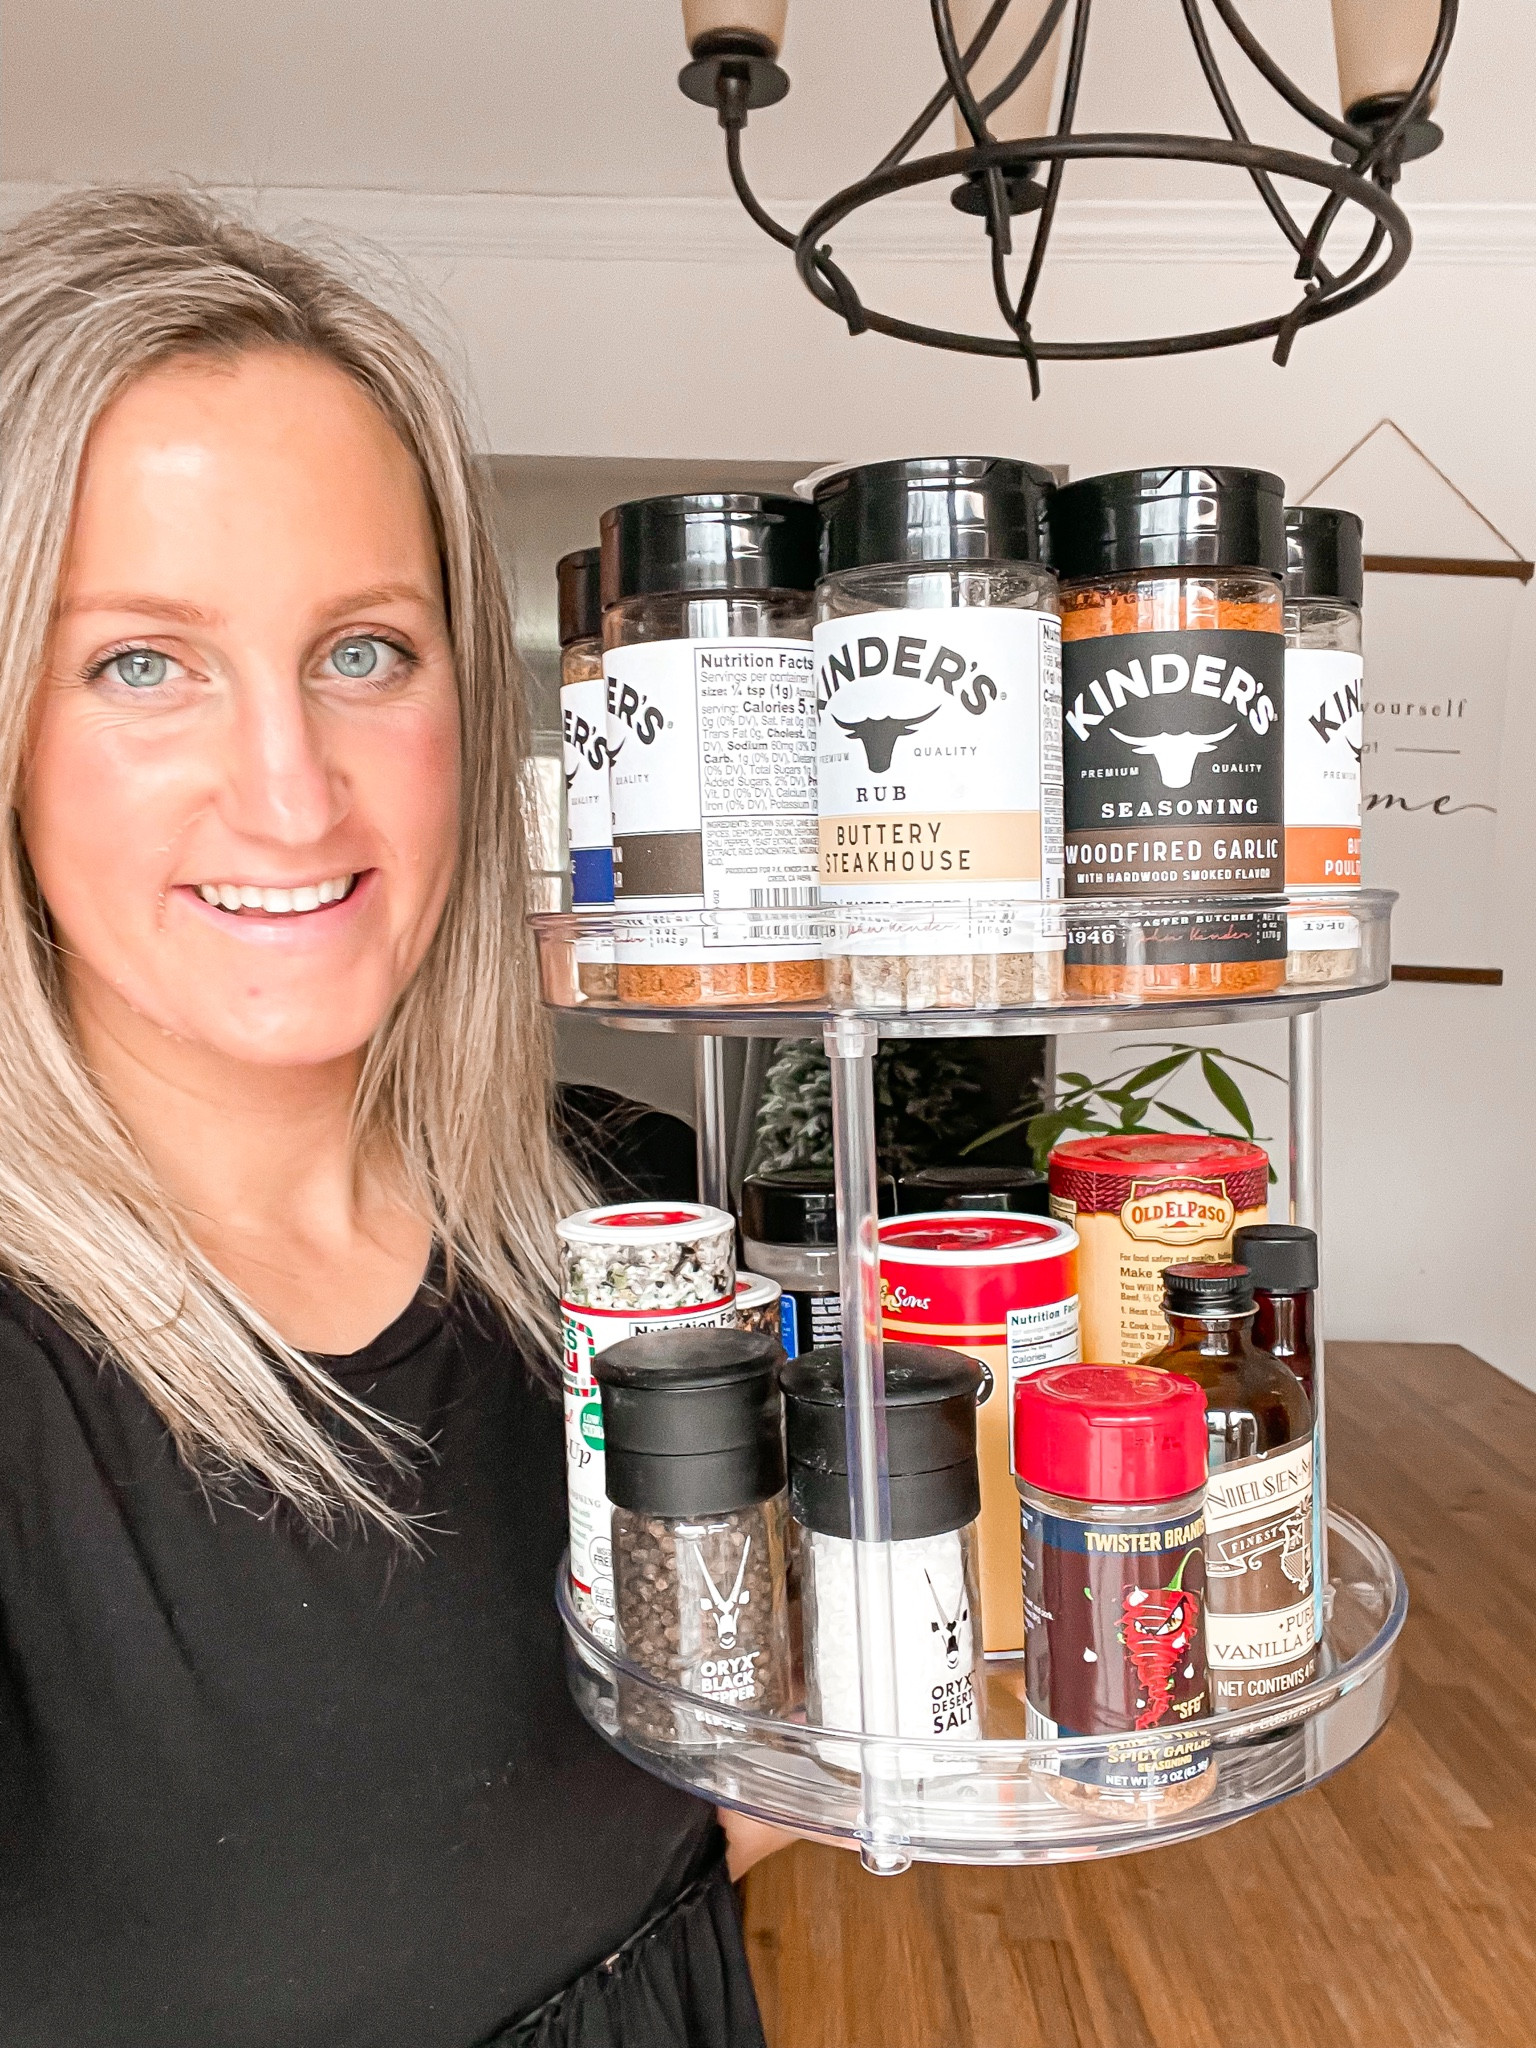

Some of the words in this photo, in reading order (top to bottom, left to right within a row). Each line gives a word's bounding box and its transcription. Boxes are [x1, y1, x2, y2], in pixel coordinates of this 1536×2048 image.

[701, 653, 774, 668] Nutrition
[779, 654, 815, 670] Facts
[700, 671, 747, 684] Servings
[751, 673, 767, 684] per
[770, 672, 810, 684] container
[701, 687, 727, 697] size:
[747, 686, 766, 698] tsp
[770, 683, 793, 700] (1g)
[1065, 653, 1275, 742] KINDER'S
[701, 703, 738, 716] serving:
[743, 700, 795, 713] Calories
[702, 729, 730, 739] Trans
[732, 728, 747, 738] Fat
[727, 740, 768, 751] Sodium
[913, 746, 978, 757] QUALITY
[704, 754, 734, 764] Carb.
[749, 764, 770, 775] Total
[774, 764, 801, 777] Sugars
[1081, 766, 1139, 779] PREMIUM
[1211, 763, 1262, 774] QUALITY
[704, 777, 734, 788] Added
[856, 786, 907, 803] RUB
[705, 801, 723, 810] Iron
[1101, 798, 1259, 820] SEASONING
[837, 822, 943, 846] BUTTERY
[1065, 839, 1202, 866] WOODFIRED
[1213, 838, 1279, 861] GARLIC
[825, 849, 972, 874] STEAKHOUSE
[1077, 873, 1103, 884] WITH
[1106, 870, 1178, 884] HARDWOOD
[1182, 868, 1232, 881] SMOKED
[1235, 867, 1270, 879] FLAVOR
[1067, 930, 1115, 945] 1946
[1132, 1205, 1163, 1224] OLD
[1133, 1253, 1149, 1262] food
[1152, 1254, 1174, 1264] safety
[1120, 1267, 1153, 1278] Make
[1011, 1309, 1060, 1326] Nutrition
[1129, 1307, 1148, 1315] Heat
[1129, 1321, 1149, 1330] Cook
[1012, 1353, 1047, 1365] Calories
[1084, 1532, 1162, 1553] TWISTER
[1231, 1526, 1279, 1553] FINEST
[1214, 1634, 1303, 1660] VANILLA
[700, 1652, 760, 1677] ORYX
[701, 1669, 756, 1692] BLACK
[932, 1669, 976, 1700] ORYX
[1217, 1680, 1245, 1697] NET
[1247, 1667, 1305, 1697] CONTENTS
[932, 1689, 972, 1714] DESERT
[933, 1701, 973, 1734] SALT
[1107, 1747, 1159, 1765] SPICY
[1163, 1739, 1212, 1758] GARLIC
[1137, 1754, 1193, 1773] SEASONING
[1106, 1775, 1129, 1786] NET
[1153, 1774, 1169, 1785] 2.2
[1169, 1771, 1184, 1782] OZ
